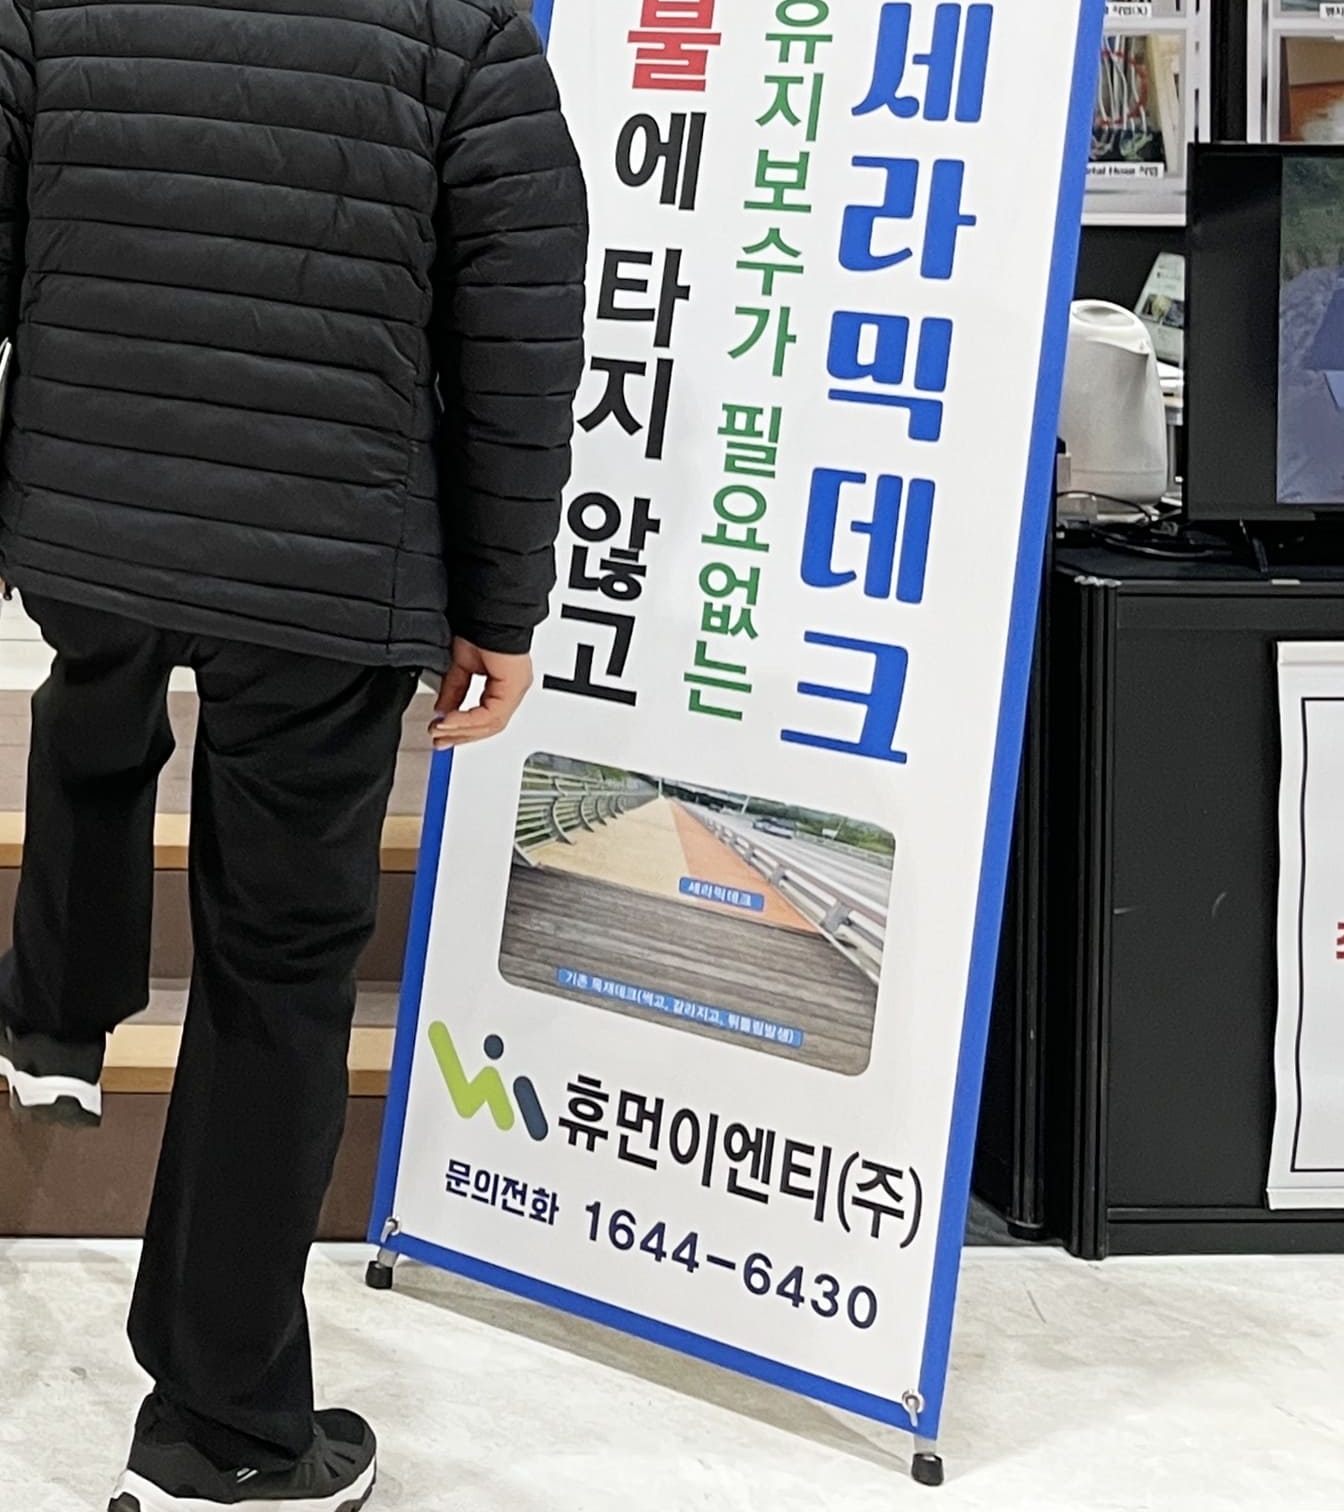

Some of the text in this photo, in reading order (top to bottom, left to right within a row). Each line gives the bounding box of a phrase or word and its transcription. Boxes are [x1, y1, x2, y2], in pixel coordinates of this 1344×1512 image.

[779, 2, 994, 765] 세라믹데크
[445, 1158, 880, 1331] 문의전화 1644-6430
[557, 1073, 925, 1249] 휴먼이엔티(주)
